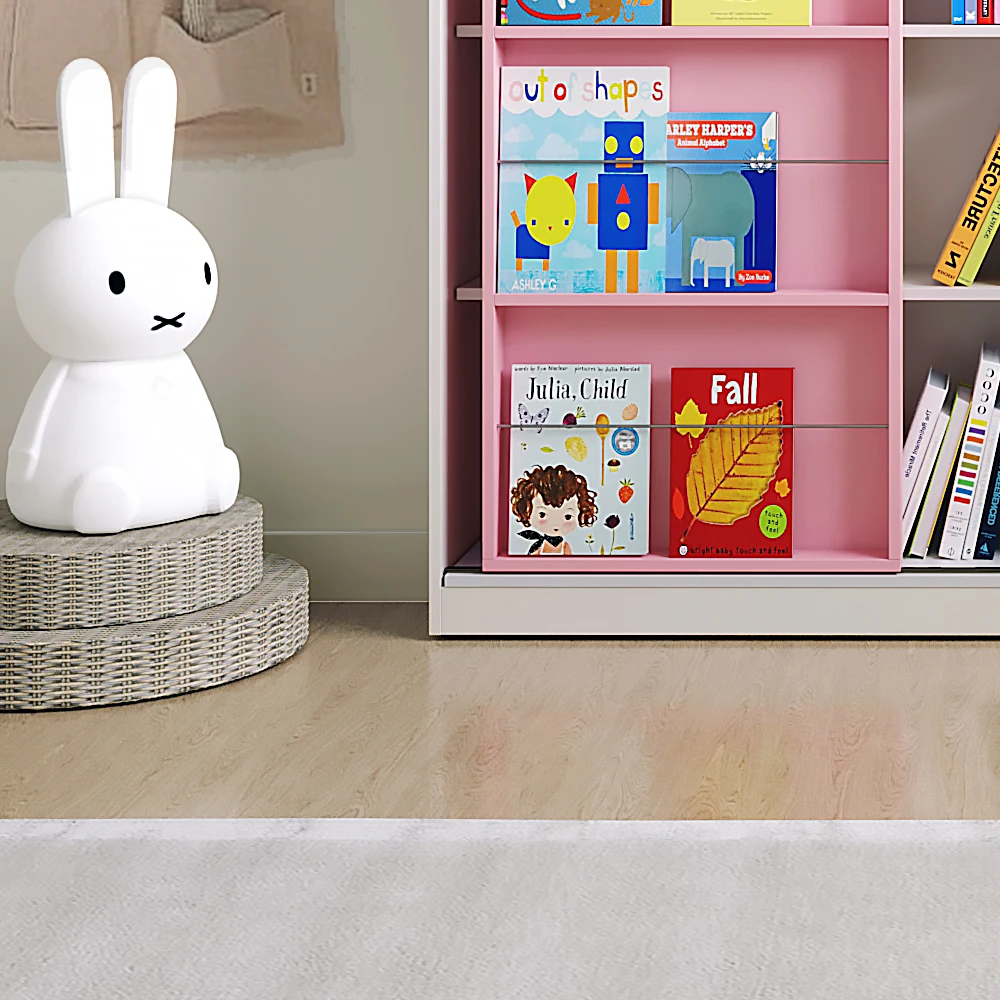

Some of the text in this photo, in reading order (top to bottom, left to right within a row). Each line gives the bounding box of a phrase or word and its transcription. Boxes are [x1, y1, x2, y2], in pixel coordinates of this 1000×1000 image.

[508, 68, 664, 113] out of shapes
[701, 124, 753, 136] HARPER'S
[677, 138, 726, 148] Animal Alphabet
[738, 273, 745, 281] By
[745, 273, 755, 281] Zoe
[511, 278, 557, 291] ASHLEY G
[526, 376, 629, 401] Julia, Child
[711, 372, 758, 404] Fall
[765, 510, 783, 518] touch
[766, 525, 779, 533] feel
[690, 546, 714, 555] bright
[715, 546, 733, 556] baby
[773, 546, 789, 554] feel
